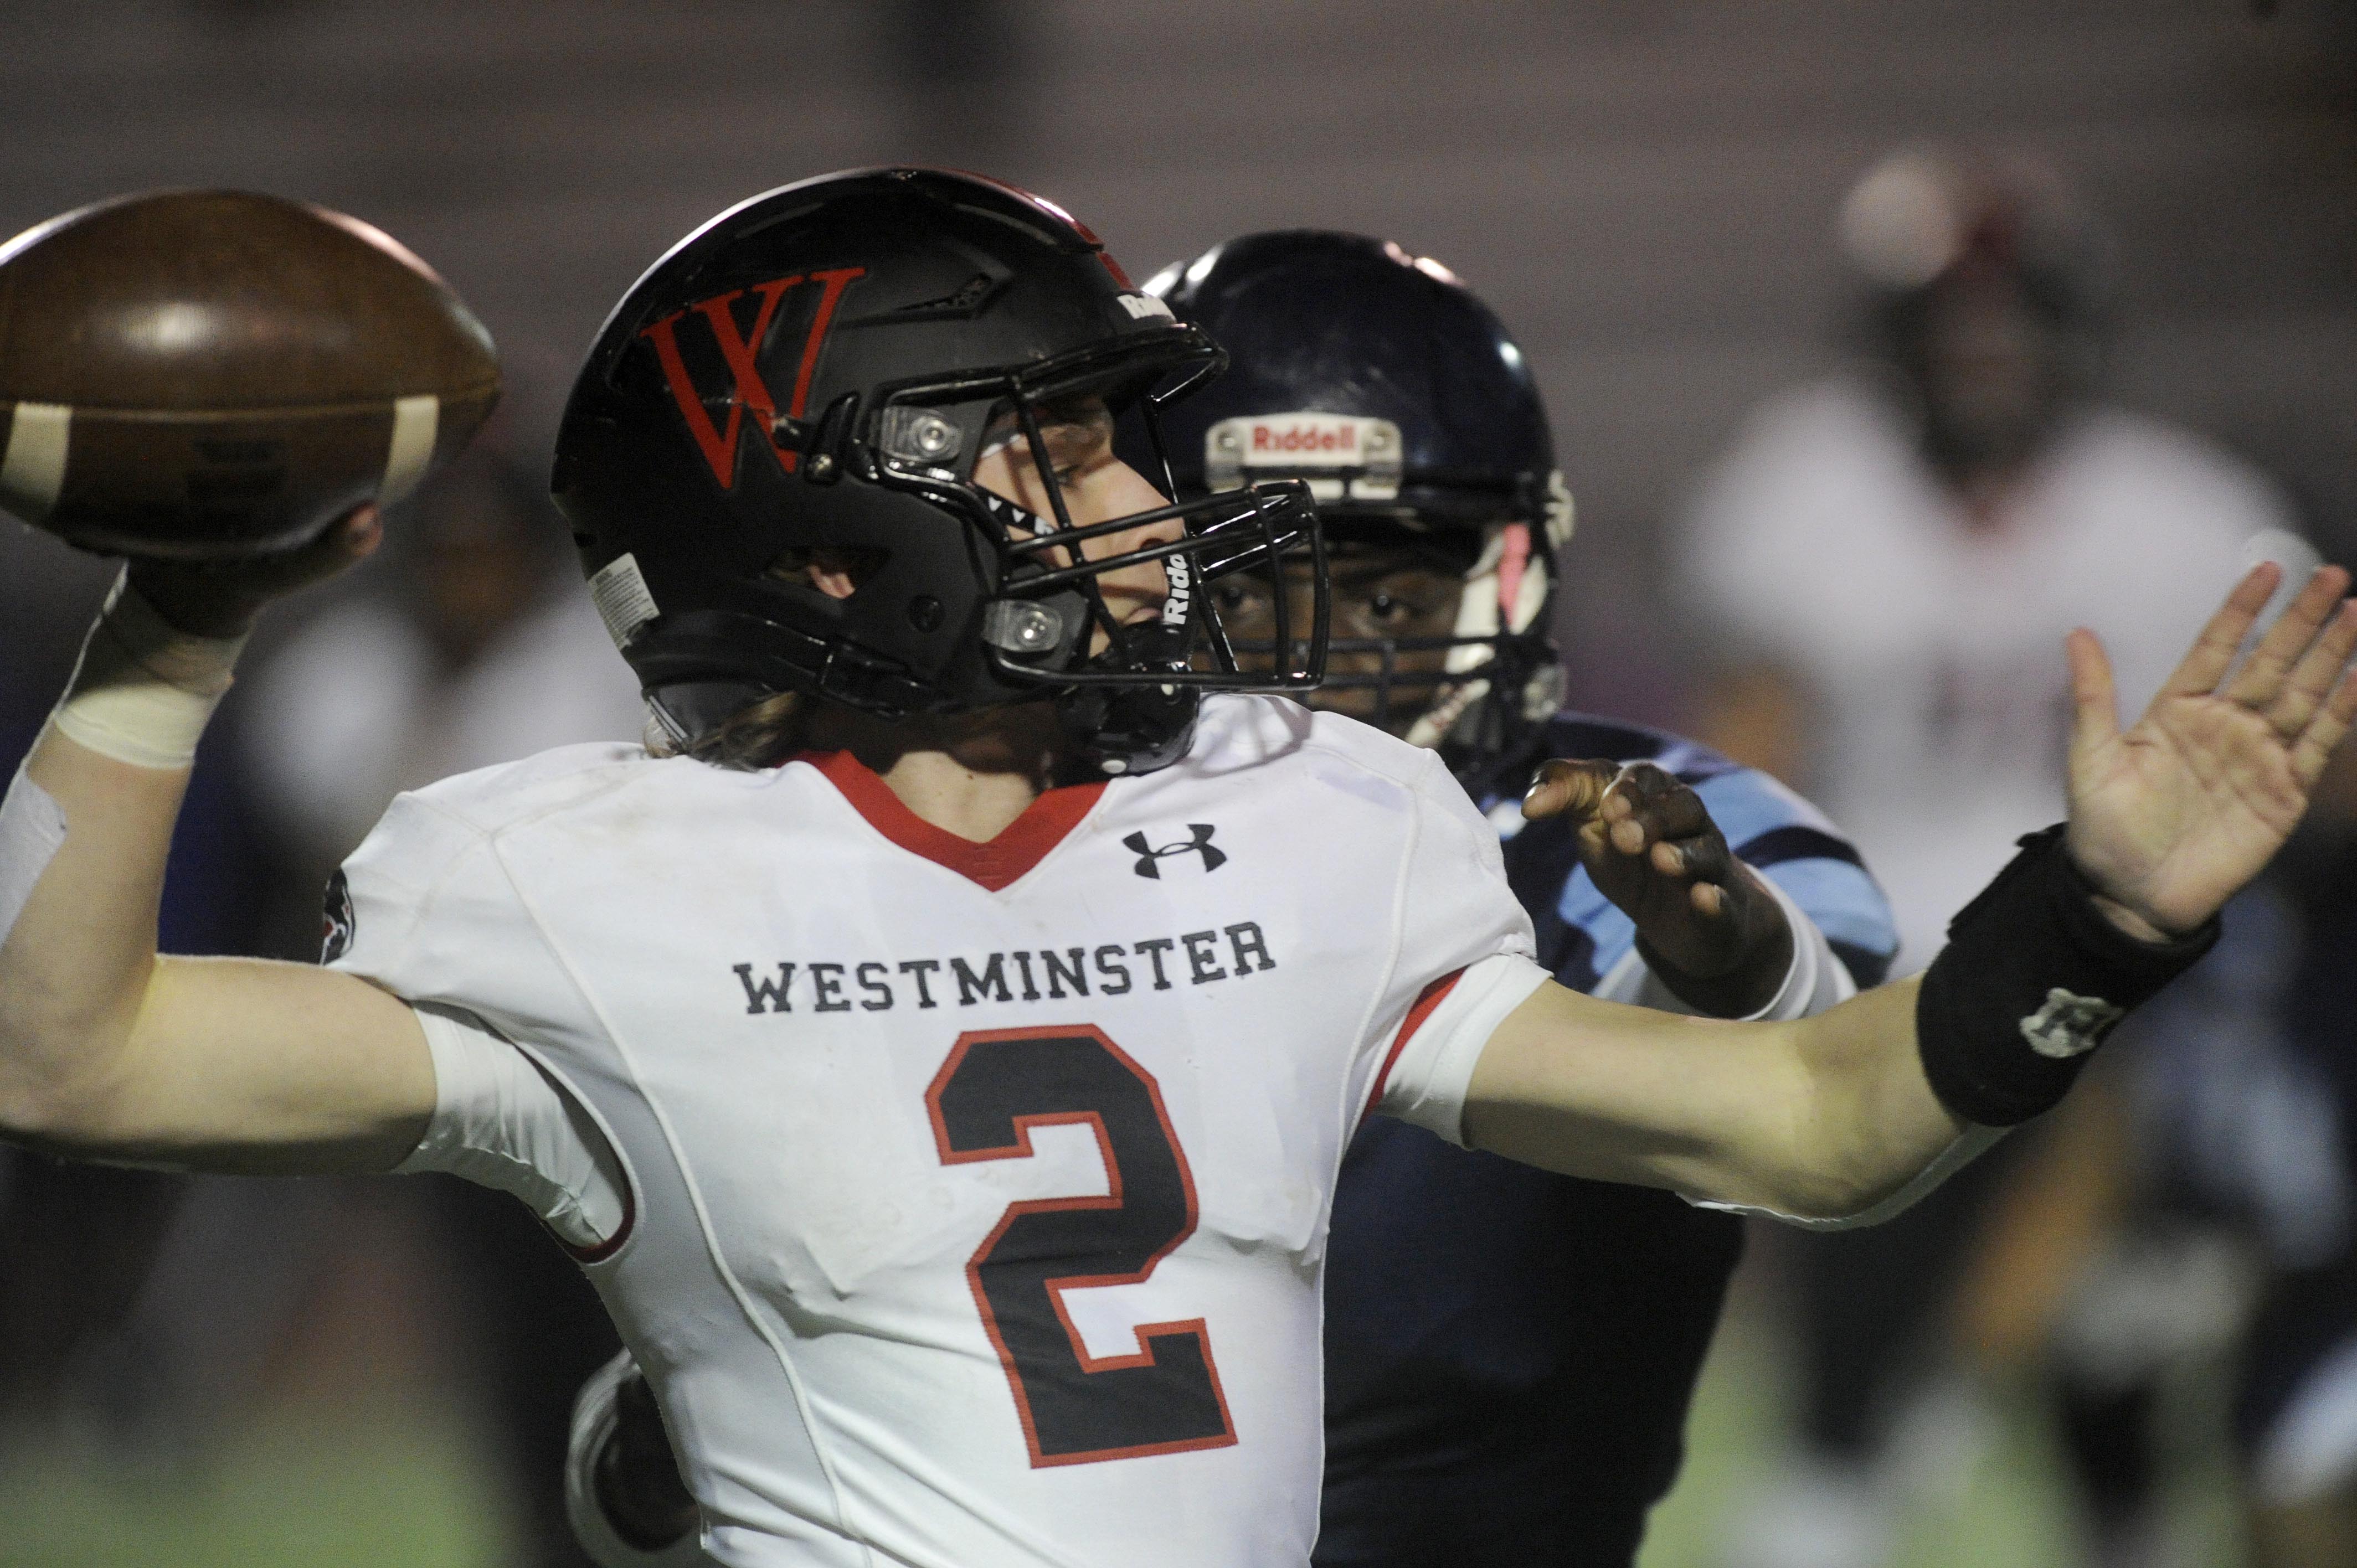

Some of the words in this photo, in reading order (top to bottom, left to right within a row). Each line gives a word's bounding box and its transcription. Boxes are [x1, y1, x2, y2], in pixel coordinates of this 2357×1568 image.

[639, 267, 866, 489] W
[1253, 425, 1355, 451] Riddell
[732, 921, 1277, 1014] WESTMINSTER
[924, 1023, 1239, 1469] 2
